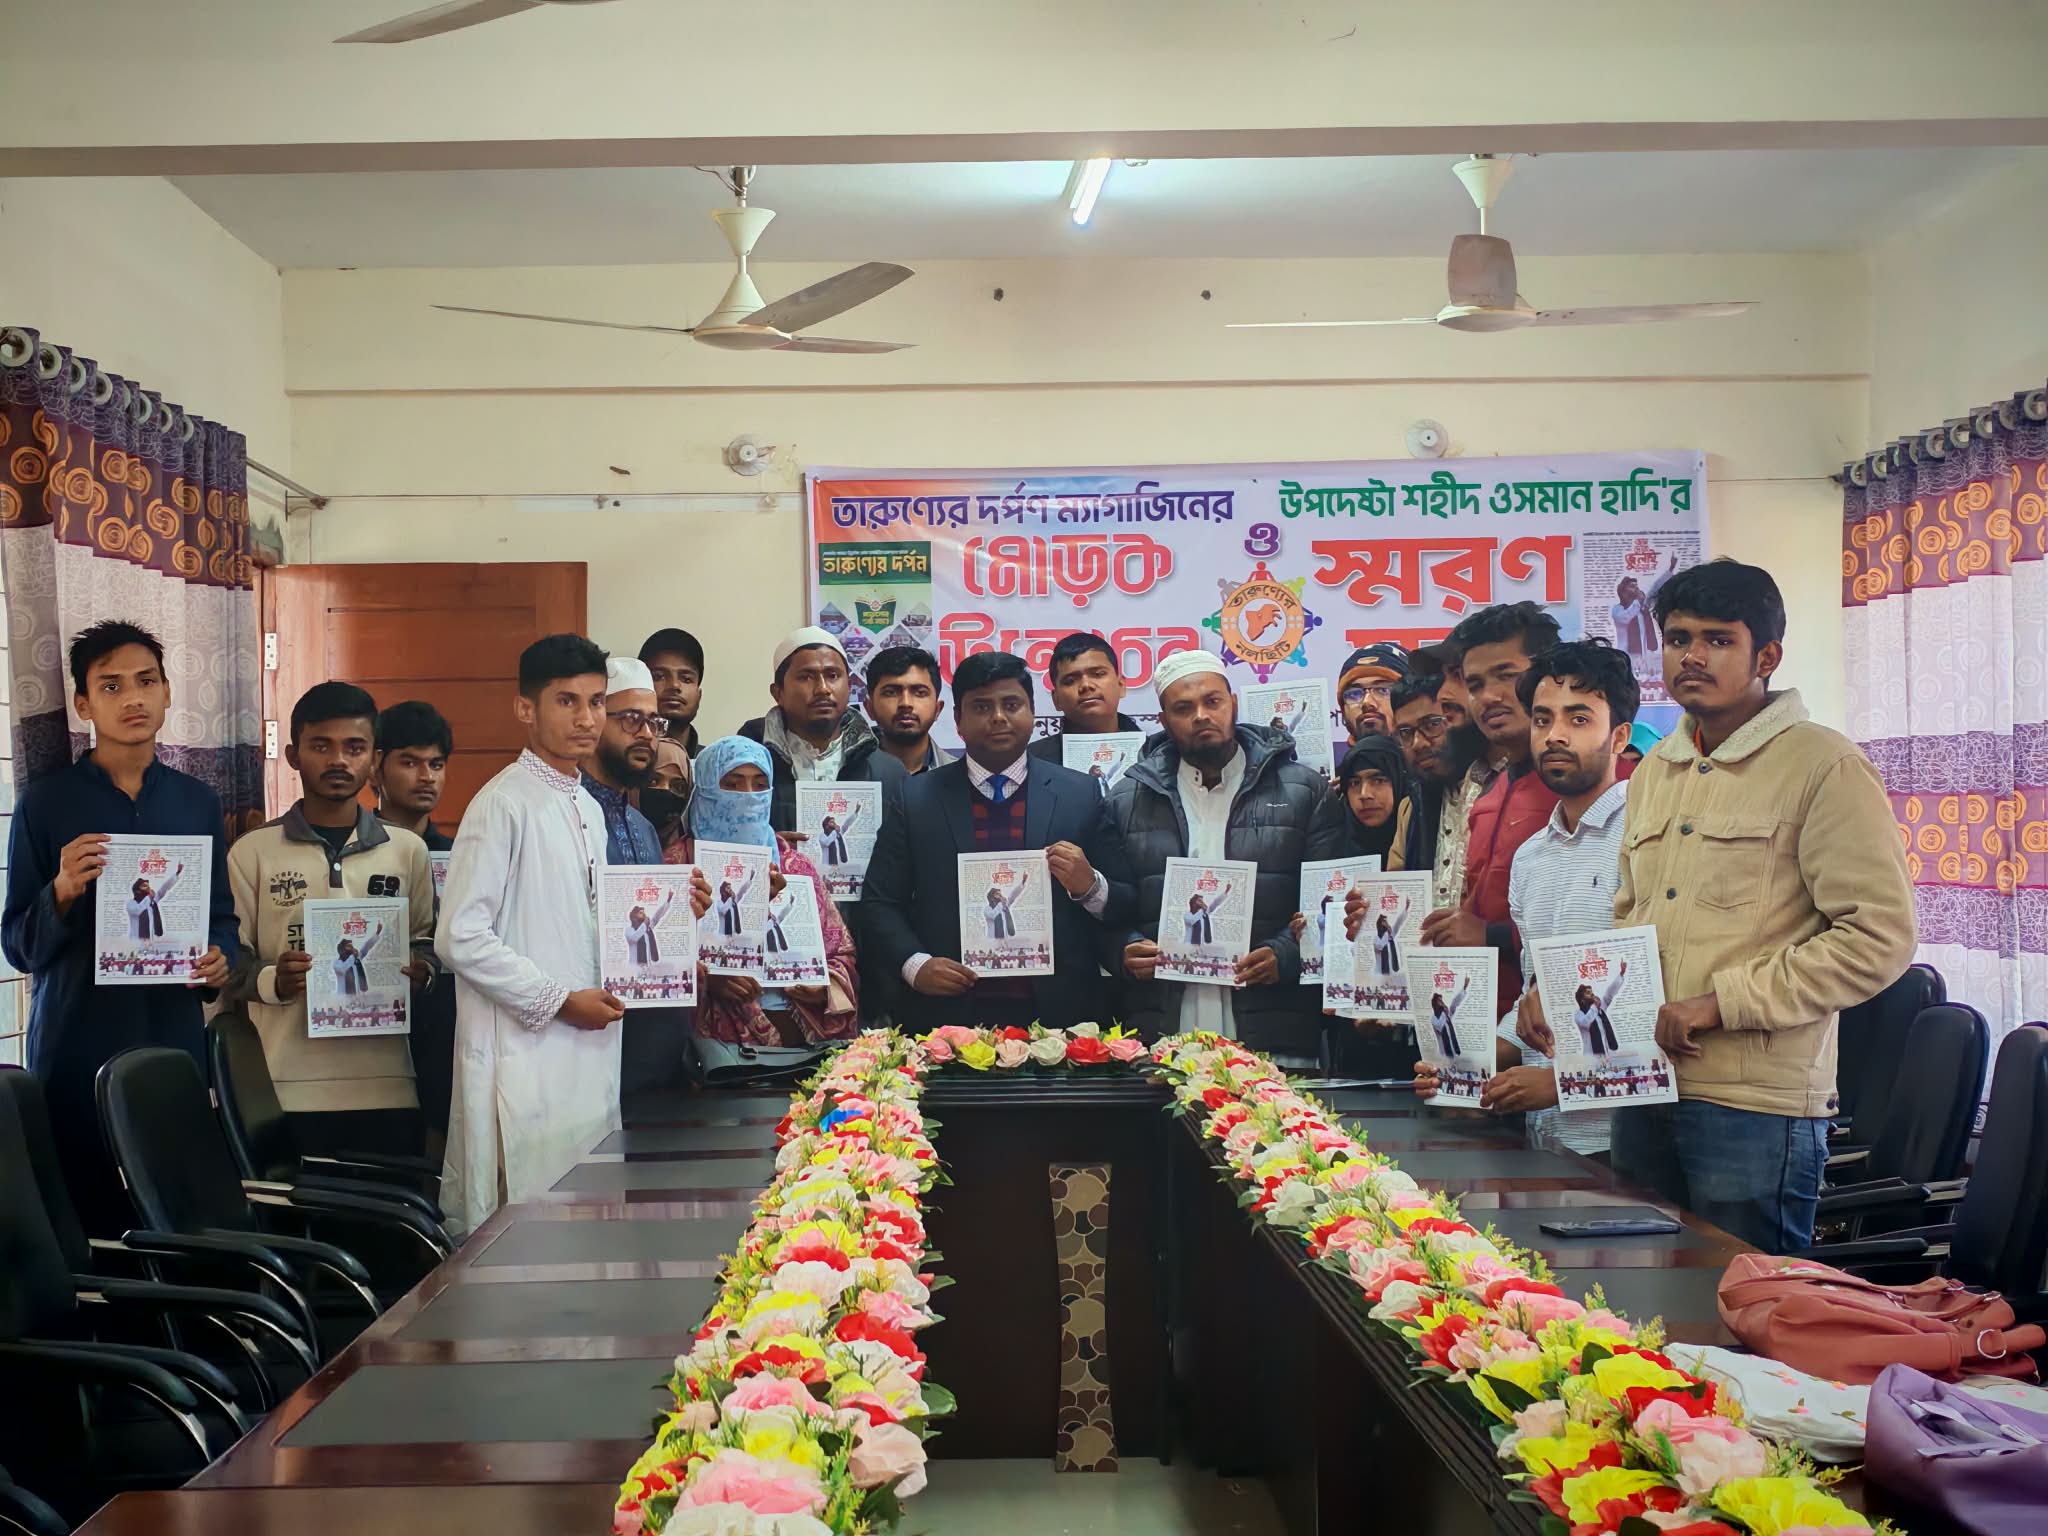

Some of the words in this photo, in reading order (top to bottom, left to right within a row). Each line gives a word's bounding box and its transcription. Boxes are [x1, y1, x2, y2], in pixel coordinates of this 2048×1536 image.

[832, 497, 970, 529] তারুণ্যের
[976, 481, 1049, 524] দর্পণ
[1055, 481, 1235, 523] ম্যাগাজিনের
[1279, 480, 1396, 518] উপদেষ্টা
[1401, 471, 1481, 519] শহীদ
[1489, 482, 1593, 513] ওসমান
[1599, 467, 1692, 515] হাদি'র
[1244, 523, 1279, 556] ও
[823, 557, 887, 577] তারুণ্যের
[964, 534, 1173, 607] মোড়ক
[1311, 536, 1572, 613] স্মরণ
